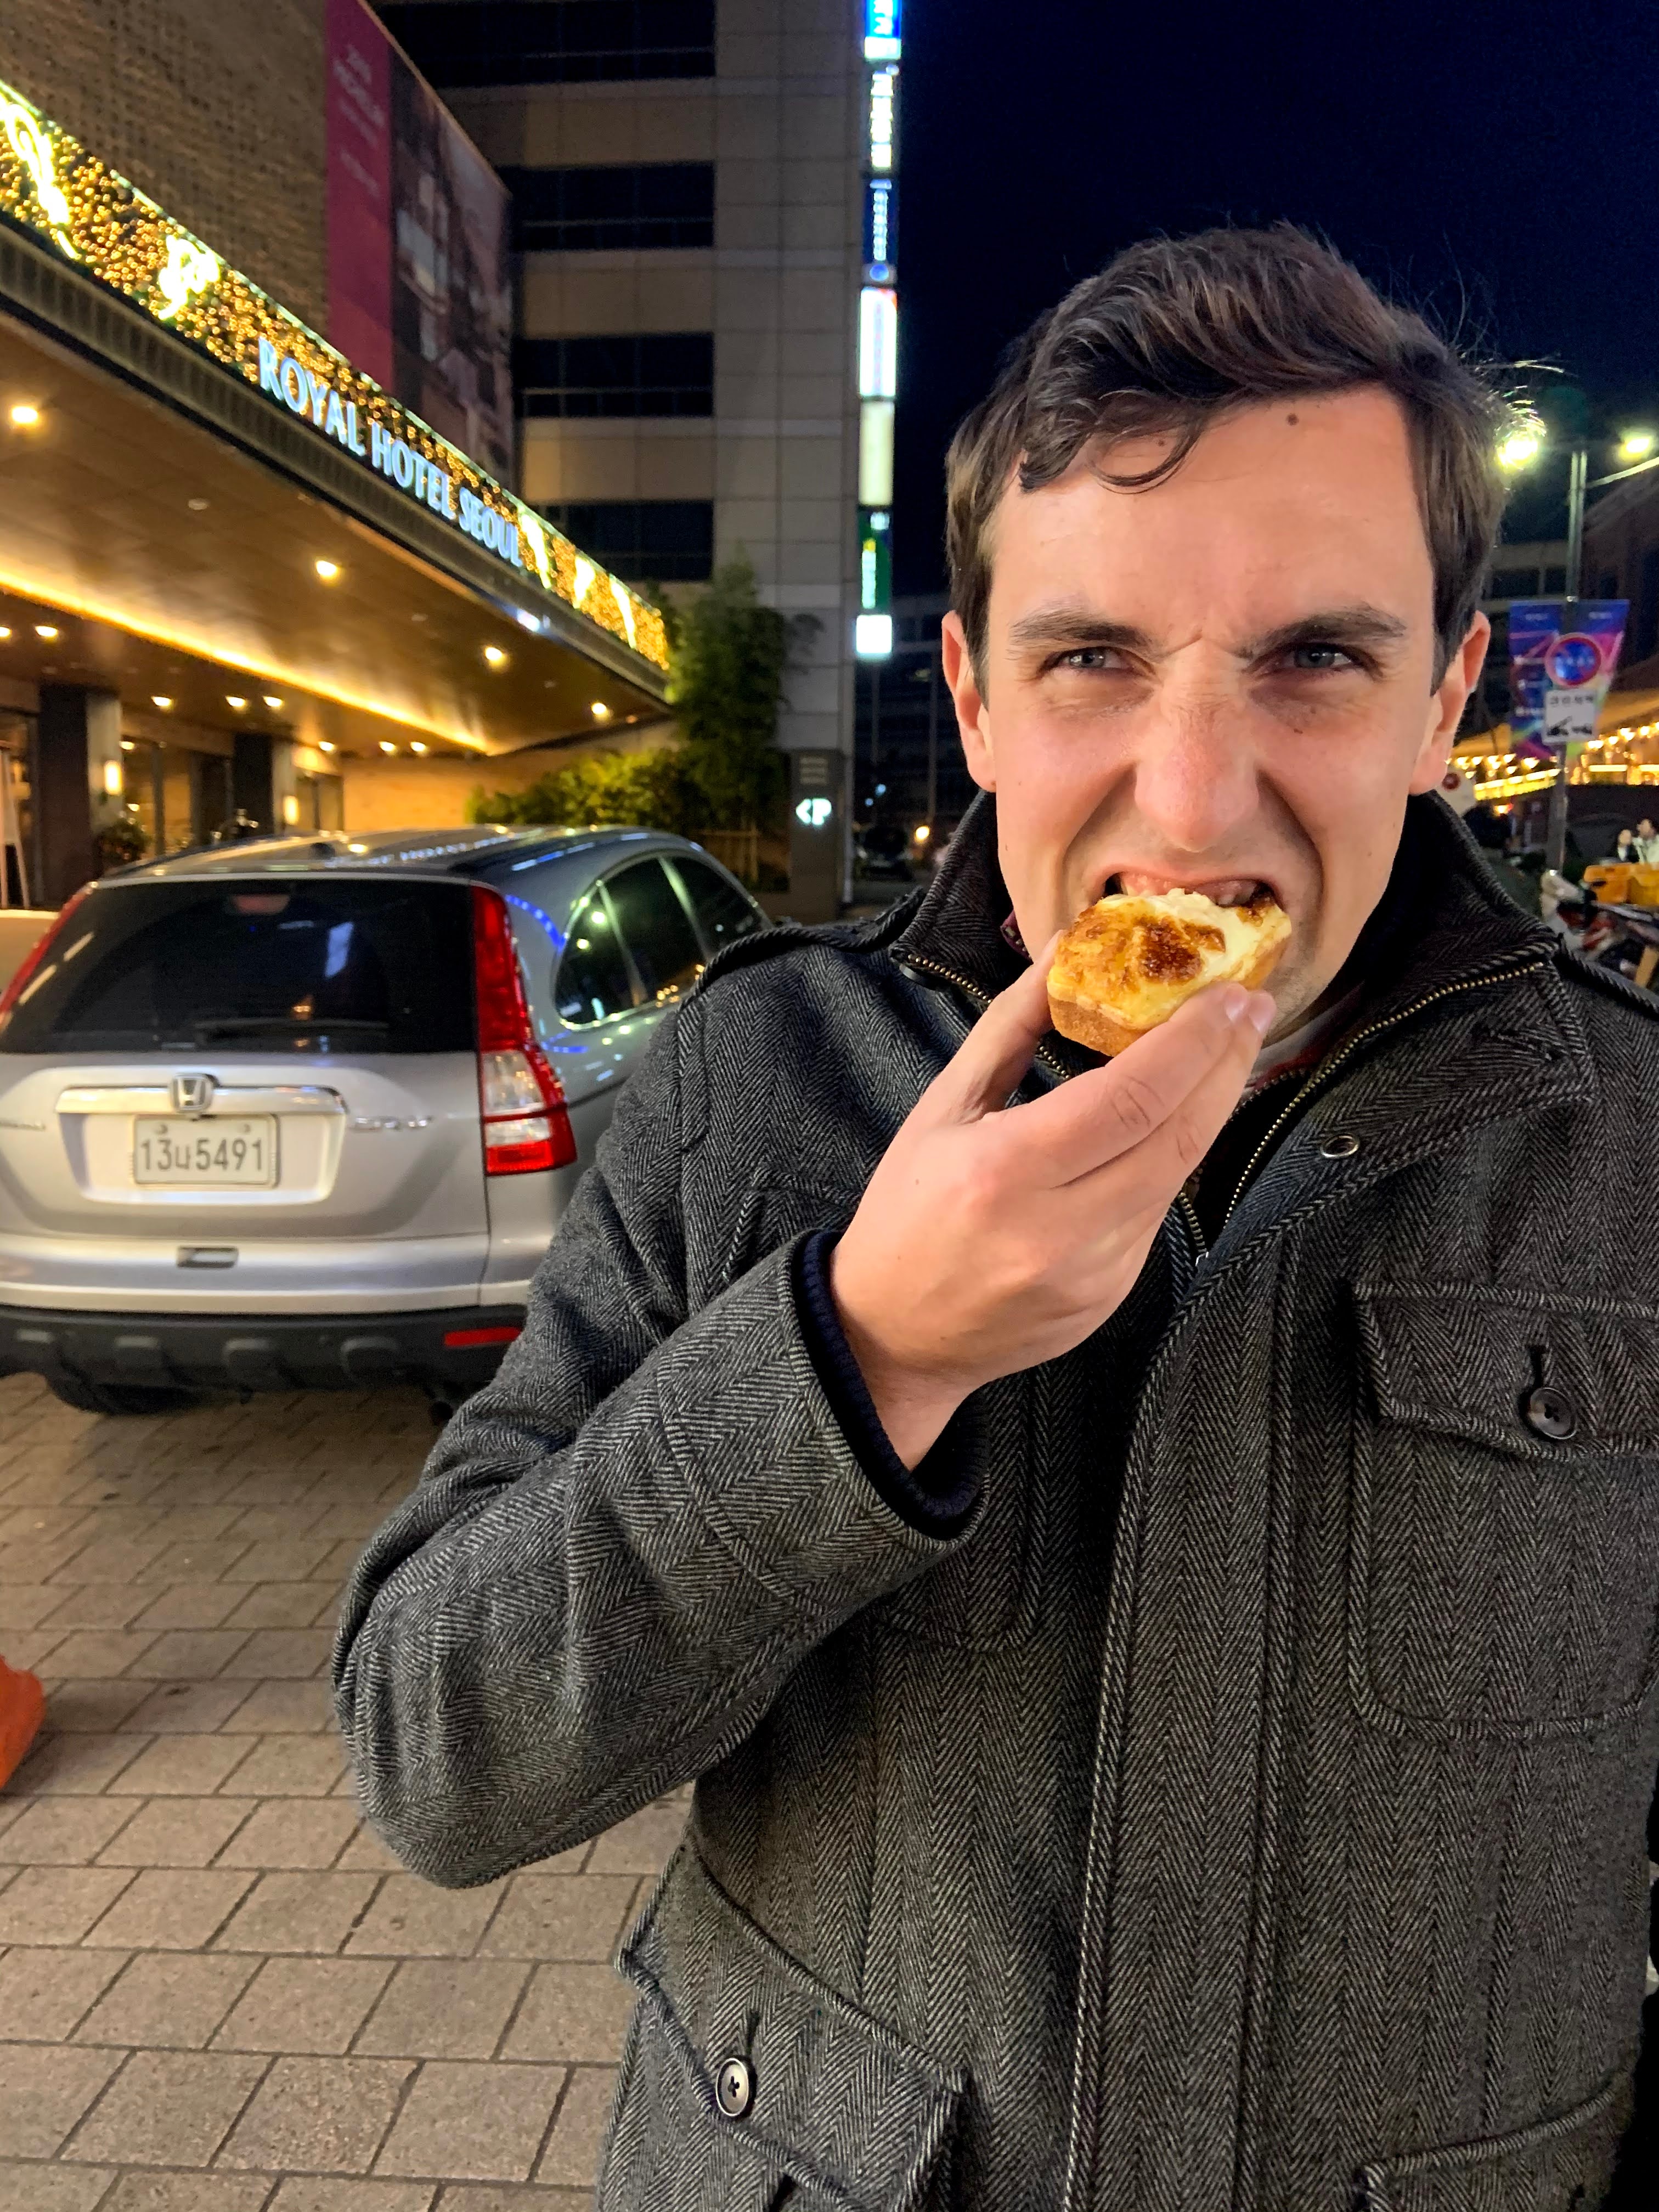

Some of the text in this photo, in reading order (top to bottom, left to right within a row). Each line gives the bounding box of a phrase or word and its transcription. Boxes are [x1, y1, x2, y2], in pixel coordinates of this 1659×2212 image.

[258, 336, 523, 568] ROYAL HOTEL SEOUL
